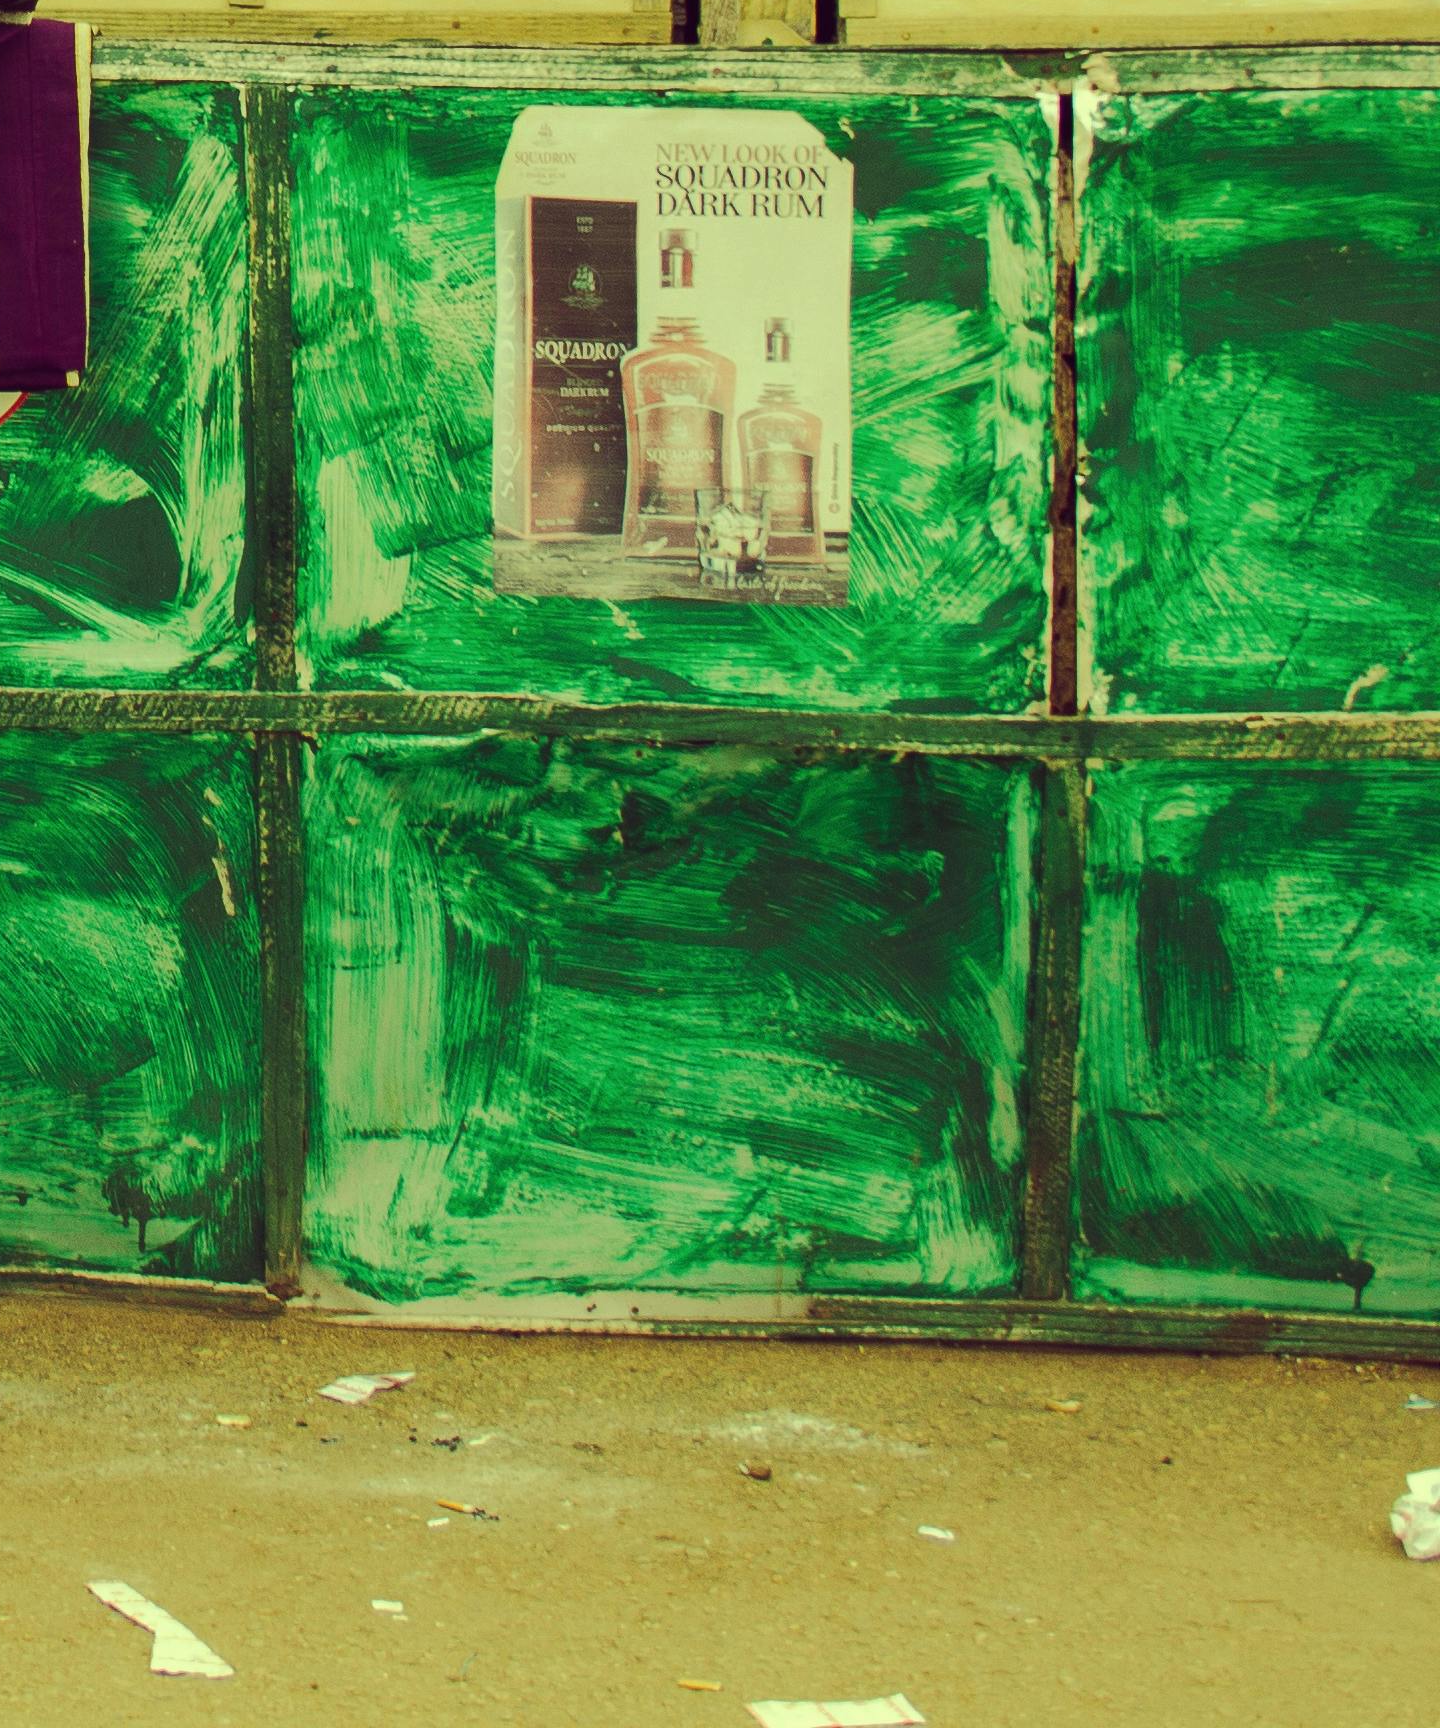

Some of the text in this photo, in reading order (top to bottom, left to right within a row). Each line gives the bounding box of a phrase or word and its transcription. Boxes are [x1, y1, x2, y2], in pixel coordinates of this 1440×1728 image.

[514, 151, 578, 167] SQUADRON
[655, 144, 825, 165] NEW LOOK OF
[655, 165, 829, 197] SQUADRON
[655, 192, 826, 219] DARK RUM
